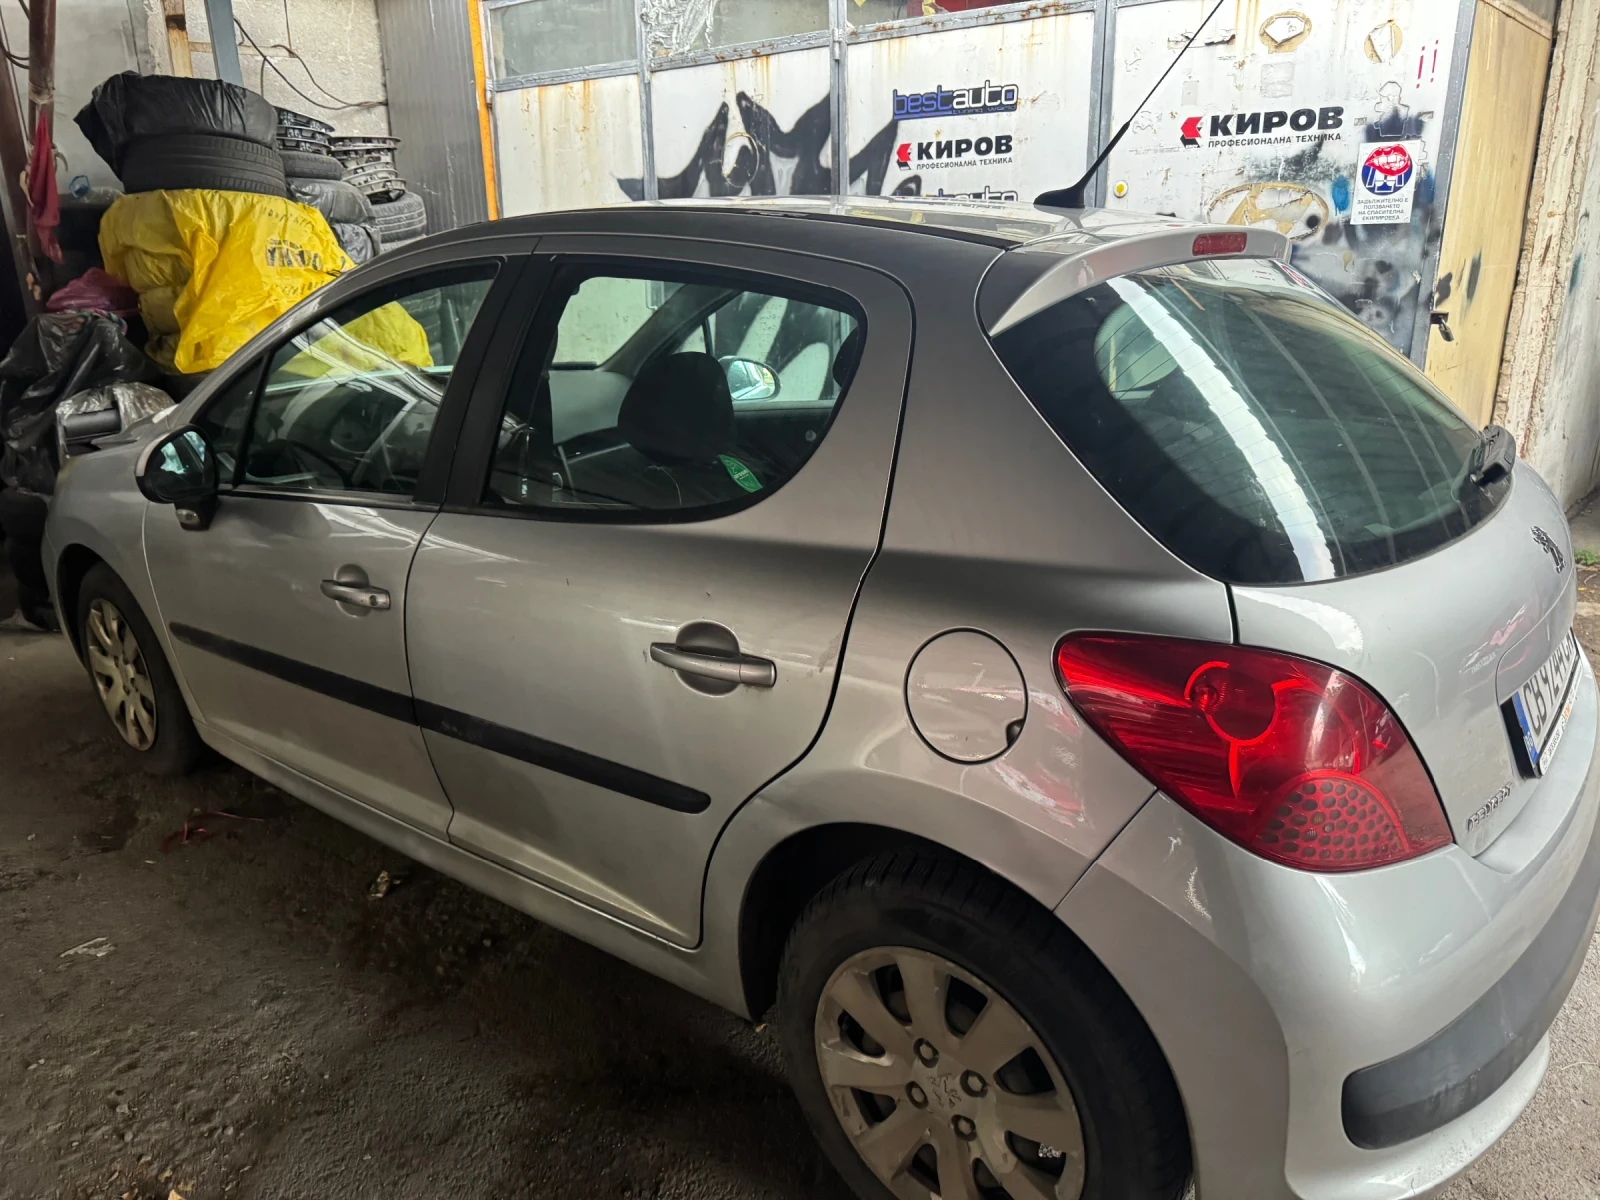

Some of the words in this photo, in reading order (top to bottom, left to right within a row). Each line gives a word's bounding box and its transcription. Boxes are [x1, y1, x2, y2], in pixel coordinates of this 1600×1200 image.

[893, 80, 1019, 115] bestauto
[1209, 106, 1345, 137] КИРОВ
[917, 135, 1013, 161] КИРОВ
[1208, 136, 1292, 148] ПРОФЕСИОНАЛНА
[1295, 132, 1341, 143] ТЕХНИКА
[916, 159, 977, 171] ПРОФЕСИОНАЛНА
[979, 157, 1013, 166] ТЕХНИКА
